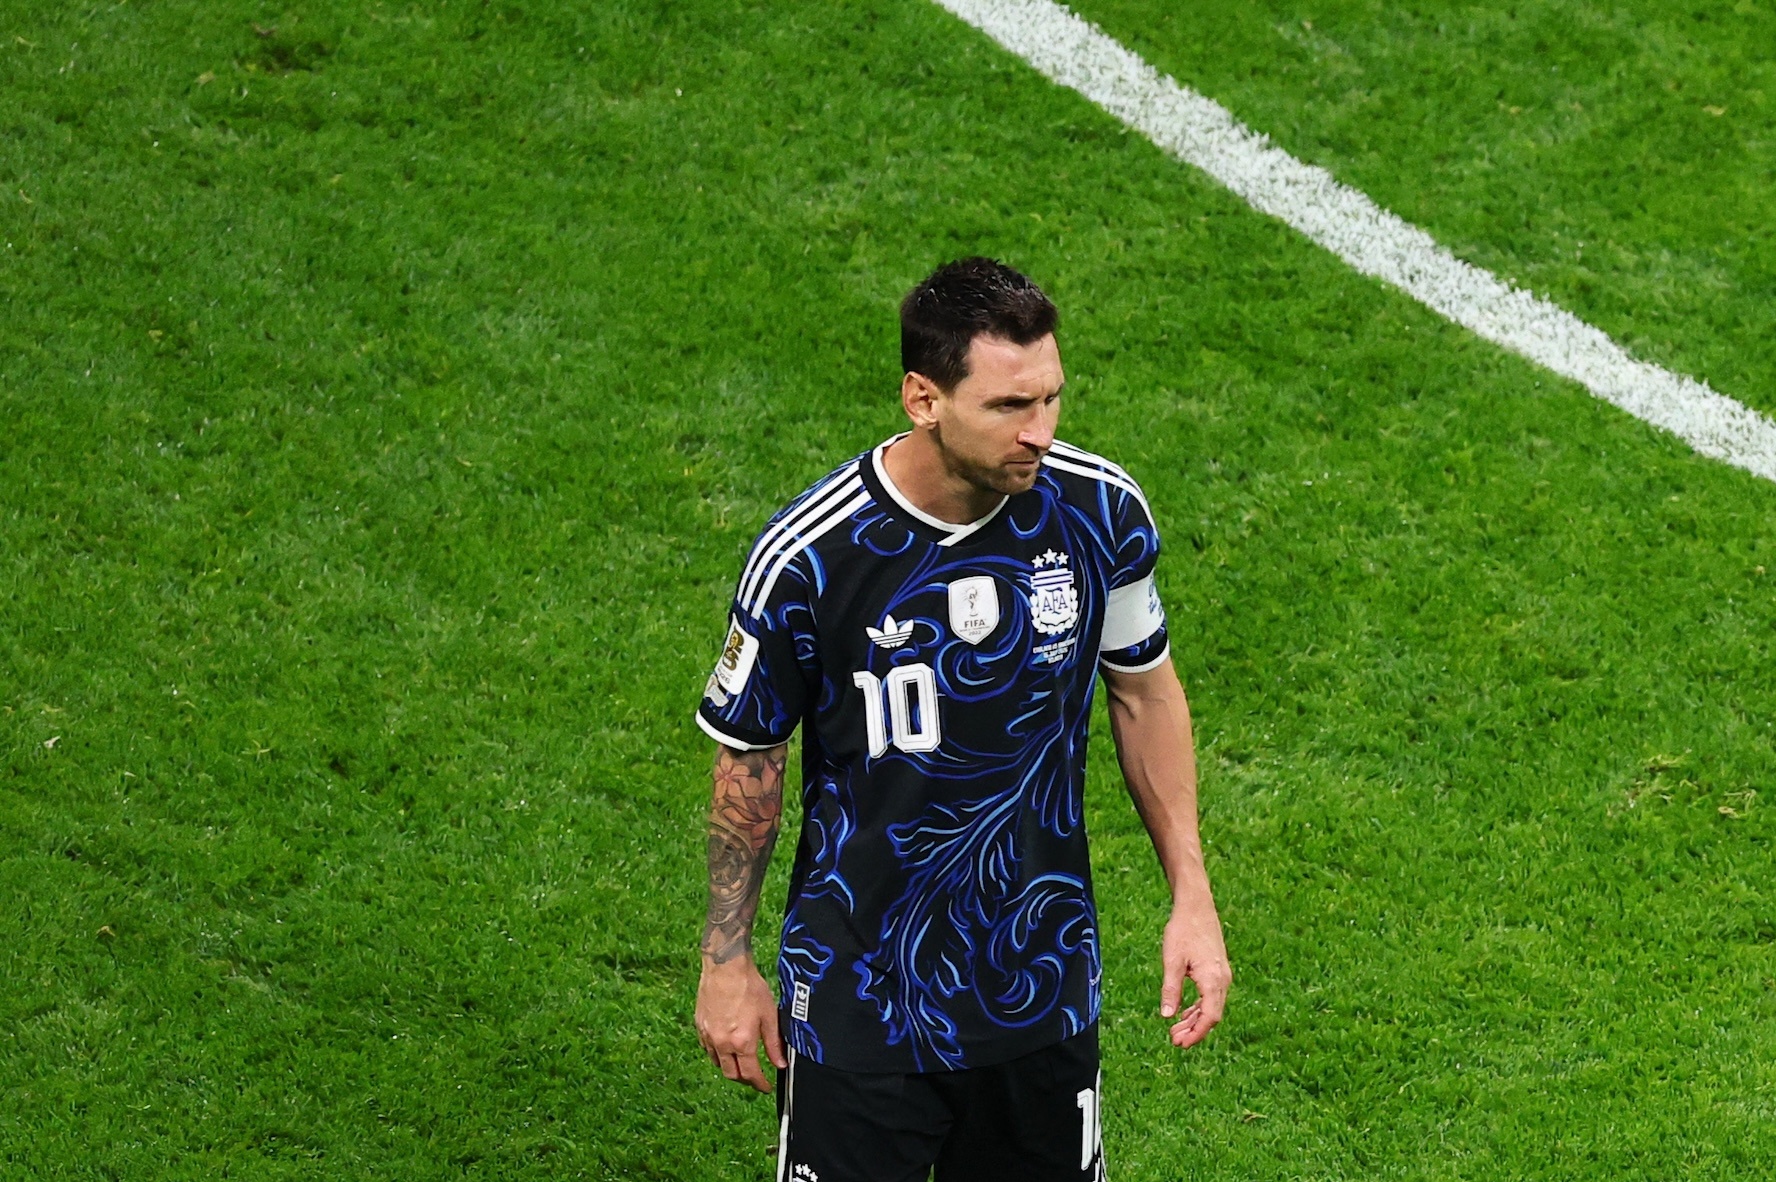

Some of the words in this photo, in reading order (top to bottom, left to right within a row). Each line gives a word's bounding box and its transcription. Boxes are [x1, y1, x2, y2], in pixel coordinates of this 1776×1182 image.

[1042, 587, 1069, 615] AFA
[964, 619, 986, 629] FIFA
[852, 662, 942, 759] 10
